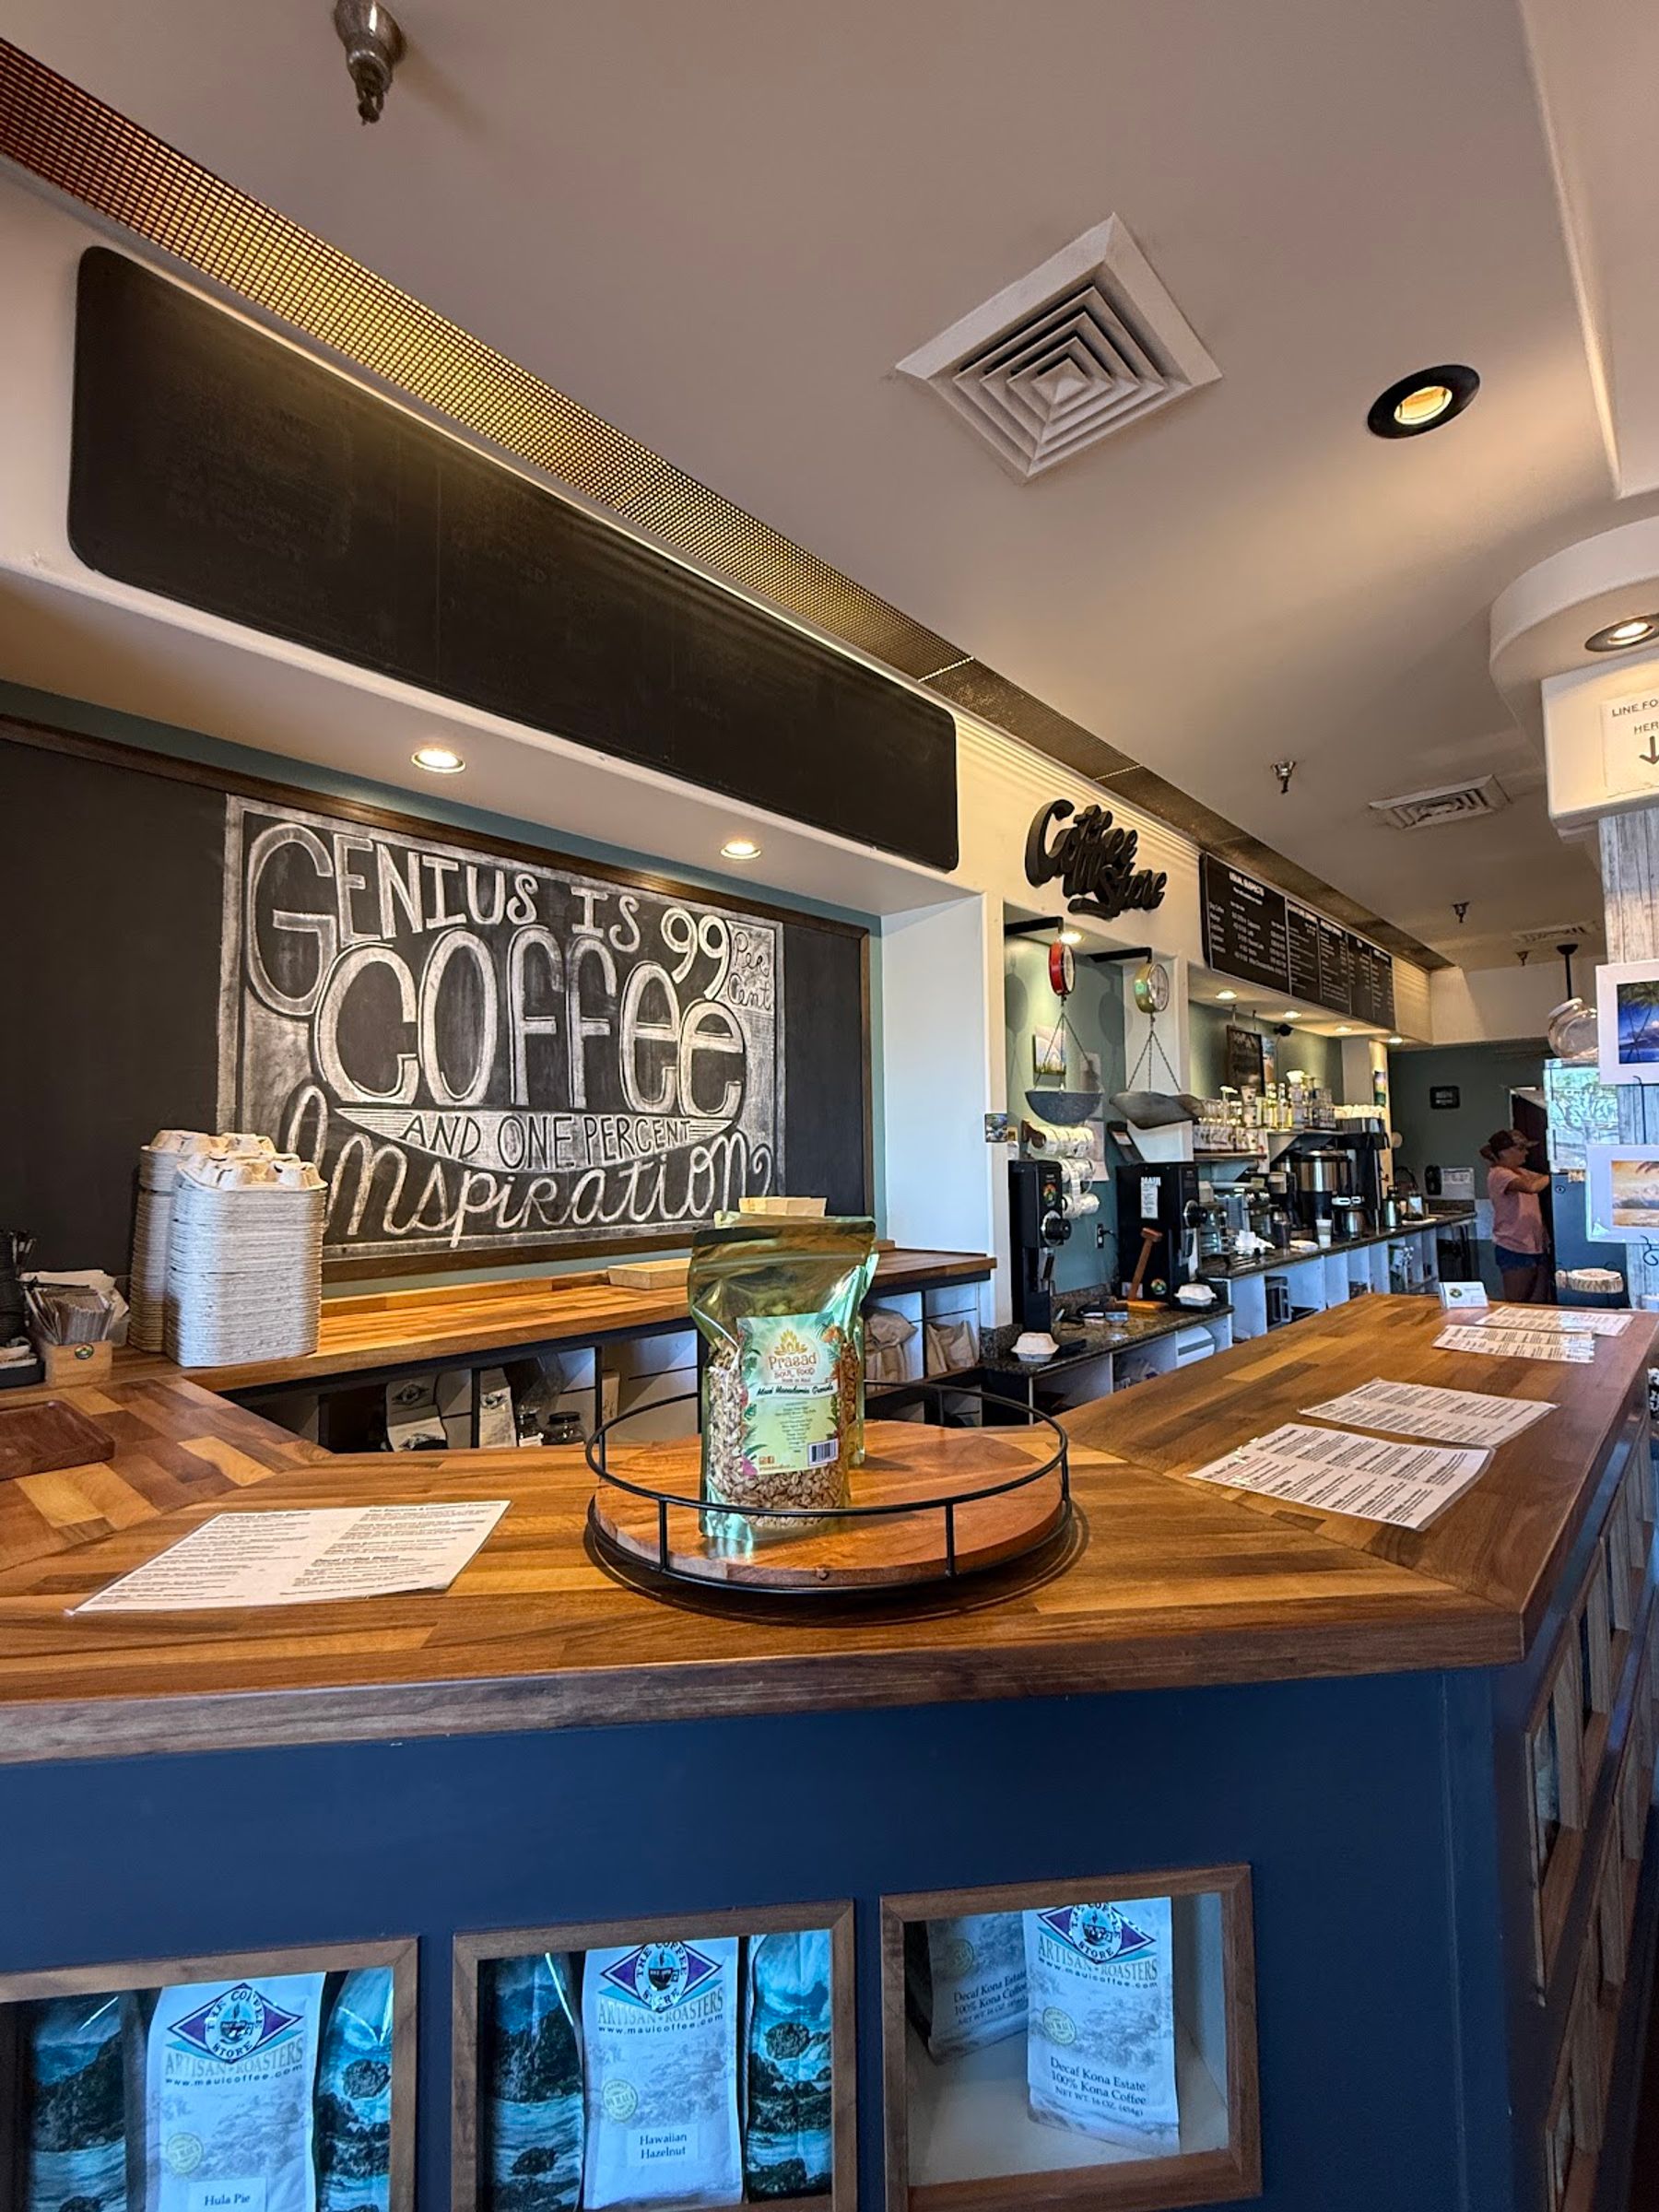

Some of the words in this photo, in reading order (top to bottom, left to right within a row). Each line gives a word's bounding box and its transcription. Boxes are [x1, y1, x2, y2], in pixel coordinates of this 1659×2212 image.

[1612, 703, 1639, 717] LINE
[1025, 799, 1137, 898] Coffee
[1067, 863, 1167, 922] Store
[246, 823, 540, 1017] GENIUS
[571, 886, 641, 953] IS
[661, 906, 732, 1000] 99
[397, 1116, 481, 1160] AND
[498, 1113, 573, 1171] ONE
[584, 1116, 692, 1161] PERCENT
[768, 1352, 818, 1370] Prasad
[1038, 1934, 1093, 1972] ARTISAN
[1100, 1959, 1159, 1982] ROASTERS
[1078, 1941, 1114, 1959] STORE
[637, 1947, 653, 1977] THE
[1038, 1956, 1159, 1989] www.mauicoffee.com
[643, 1988, 681, 2006] SRE
[953, 1987, 979, 2003] Decaf
[981, 1981, 1003, 1995] Kona
[979, 1994, 1001, 2008] Kona
[597, 1999, 656, 2026] ARTISAN
[665, 1986, 724, 2024] ROASTERS
[597, 2014, 724, 2034] www.mauicoffee.com
[165, 2052, 227, 2077] ARTISAN
[236, 2038, 304, 2075] ROASTERS
[212, 2041, 253, 2057] STORE
[165, 2064, 303, 2087] www.mauicoffee.com
[1051, 2056, 1080, 2077] Decaf
[1082, 2067, 1111, 2085] Kona
[1113, 2076, 1147, 2092] Estate
[1051, 2070, 1077, 2090] 100%
[1080, 2080, 1109, 2098] Kona
[1112, 2088, 1147, 2105] Coffee
[1055, 2086, 1072, 2098] NET
[640, 2133, 688, 2147] Hawaiian
[641, 2146, 686, 2159] Hazelnut
[204, 2194, 230, 2206] Hula
[233, 2193, 251, 2204] Pie
